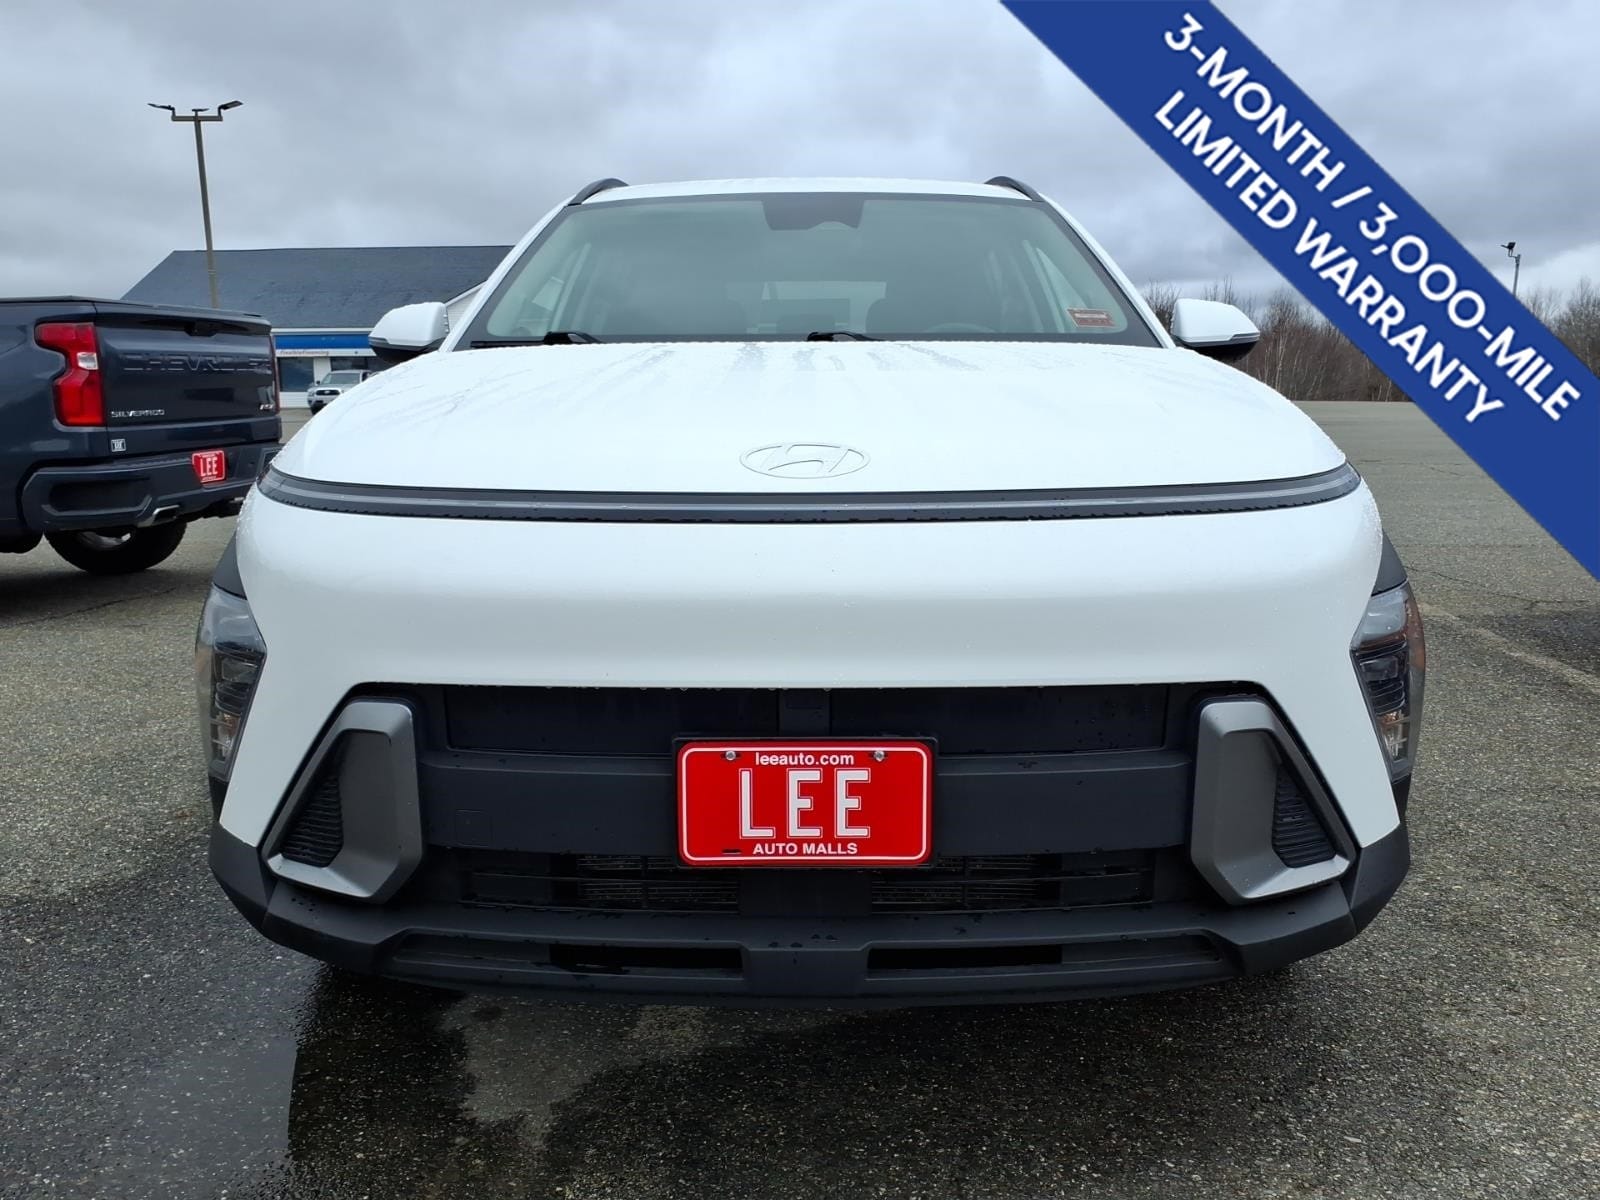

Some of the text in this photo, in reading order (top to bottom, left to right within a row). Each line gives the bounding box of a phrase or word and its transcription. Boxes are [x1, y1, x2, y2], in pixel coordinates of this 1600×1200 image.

[200, 456, 219, 477] LEE
[755, 752, 855, 766] leeauto.com
[738, 767, 871, 840] LEE
[752, 843, 858, 855] AUTO MALLS
